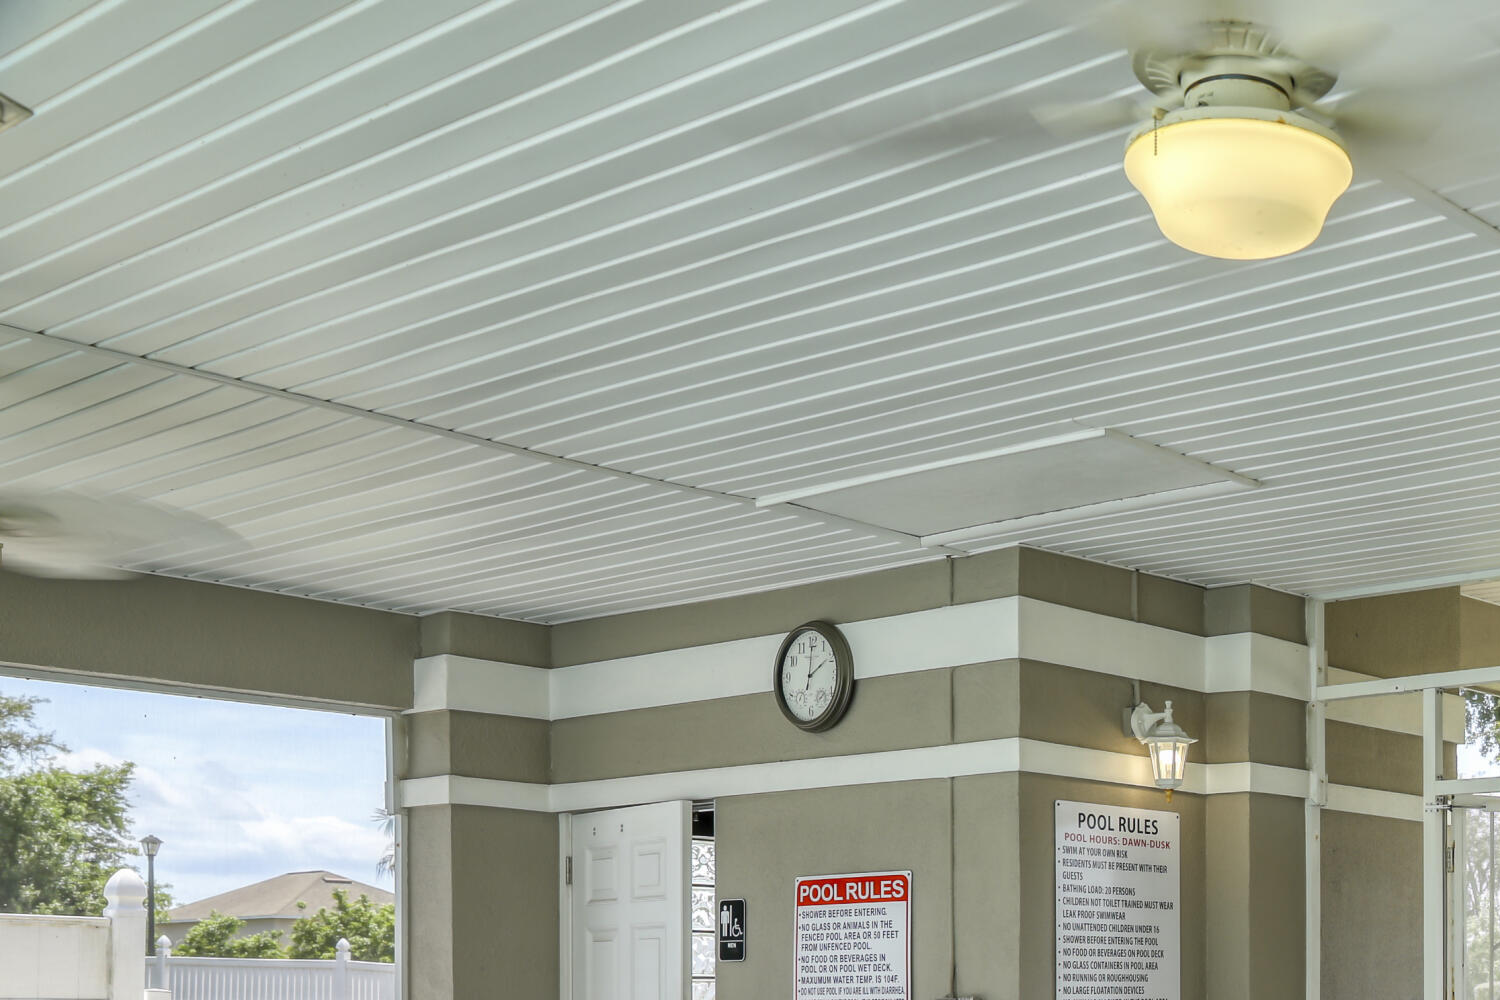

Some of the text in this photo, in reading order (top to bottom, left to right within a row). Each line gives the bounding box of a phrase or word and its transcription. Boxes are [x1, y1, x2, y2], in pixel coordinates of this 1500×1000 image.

[1078, 813, 1158, 834] POOL RULES
[1064, 833, 1170, 849] POOL HOURS: DAWN-DUSK
[1063, 846, 1128, 858] SWIM AT YOUR OWN RISK
[1063, 871, 1083, 880] GUESTS
[800, 880, 904, 902] POOL RULES
[1063, 884, 1086, 893] BATHING
[1113, 887, 1135, 896] PERSONS
[1063, 897, 1173, 910] CHILDREN NOT TOILET TRAINED MUST WEAR
[802, 910, 826, 919] SHOWER
[828, 909, 852, 918] BEFORE
[1063, 910, 1076, 918] LEAK
[1097, 911, 1125, 919] SWIMWEAR
[812, 923, 830, 931] GLASS
[833, 922, 840, 930] OR
[843, 921, 869, 929] ANIMALS
[880, 920, 892, 928] THE
[1072, 923, 1107, 932] UNATTENDED
[1109, 924, 1134, 932] CHILDREN
[1135, 925, 1152, 933] UNDER
[802, 933, 824, 941] FENCED
[826, 932, 842, 940] POOL
[844, 932, 860, 940] AREA
[863, 931, 871, 939] OR
[883, 930, 898, 938] FEET
[1063, 935, 1086, 944] SHOWER
[1087, 936, 1106, 944] BEFORE
[1108, 937, 1133, 945] ENTERING
[820, 943, 851, 951] UNFENCED
[1063, 948, 1071, 956] NO
[1097, 949, 1126, 957] BEVERAGES
[1137, 950, 1149, 958] POOL
[1151, 950, 1164, 958] DECK
[812, 955, 827, 963] FOOD
[840, 954, 877, 962] BEVERAGES
[801, 965, 817, 973] POOL
[858, 964, 870, 972] WET
[1063, 961, 1071, 969] NO
[1072, 961, 1089, 969] GLASS
[1090, 961, 1122, 969] CONTAINERS
[1131, 962, 1143, 970] POOL
[1145, 962, 1158, 970] AREA
[833, 976, 853, 984] WATER
[876, 975, 881, 983] IS
[1072, 974, 1097, 982] RUNNING
[1063, 986, 1144, 994] NO LARGE FLOATATION DEVICES
